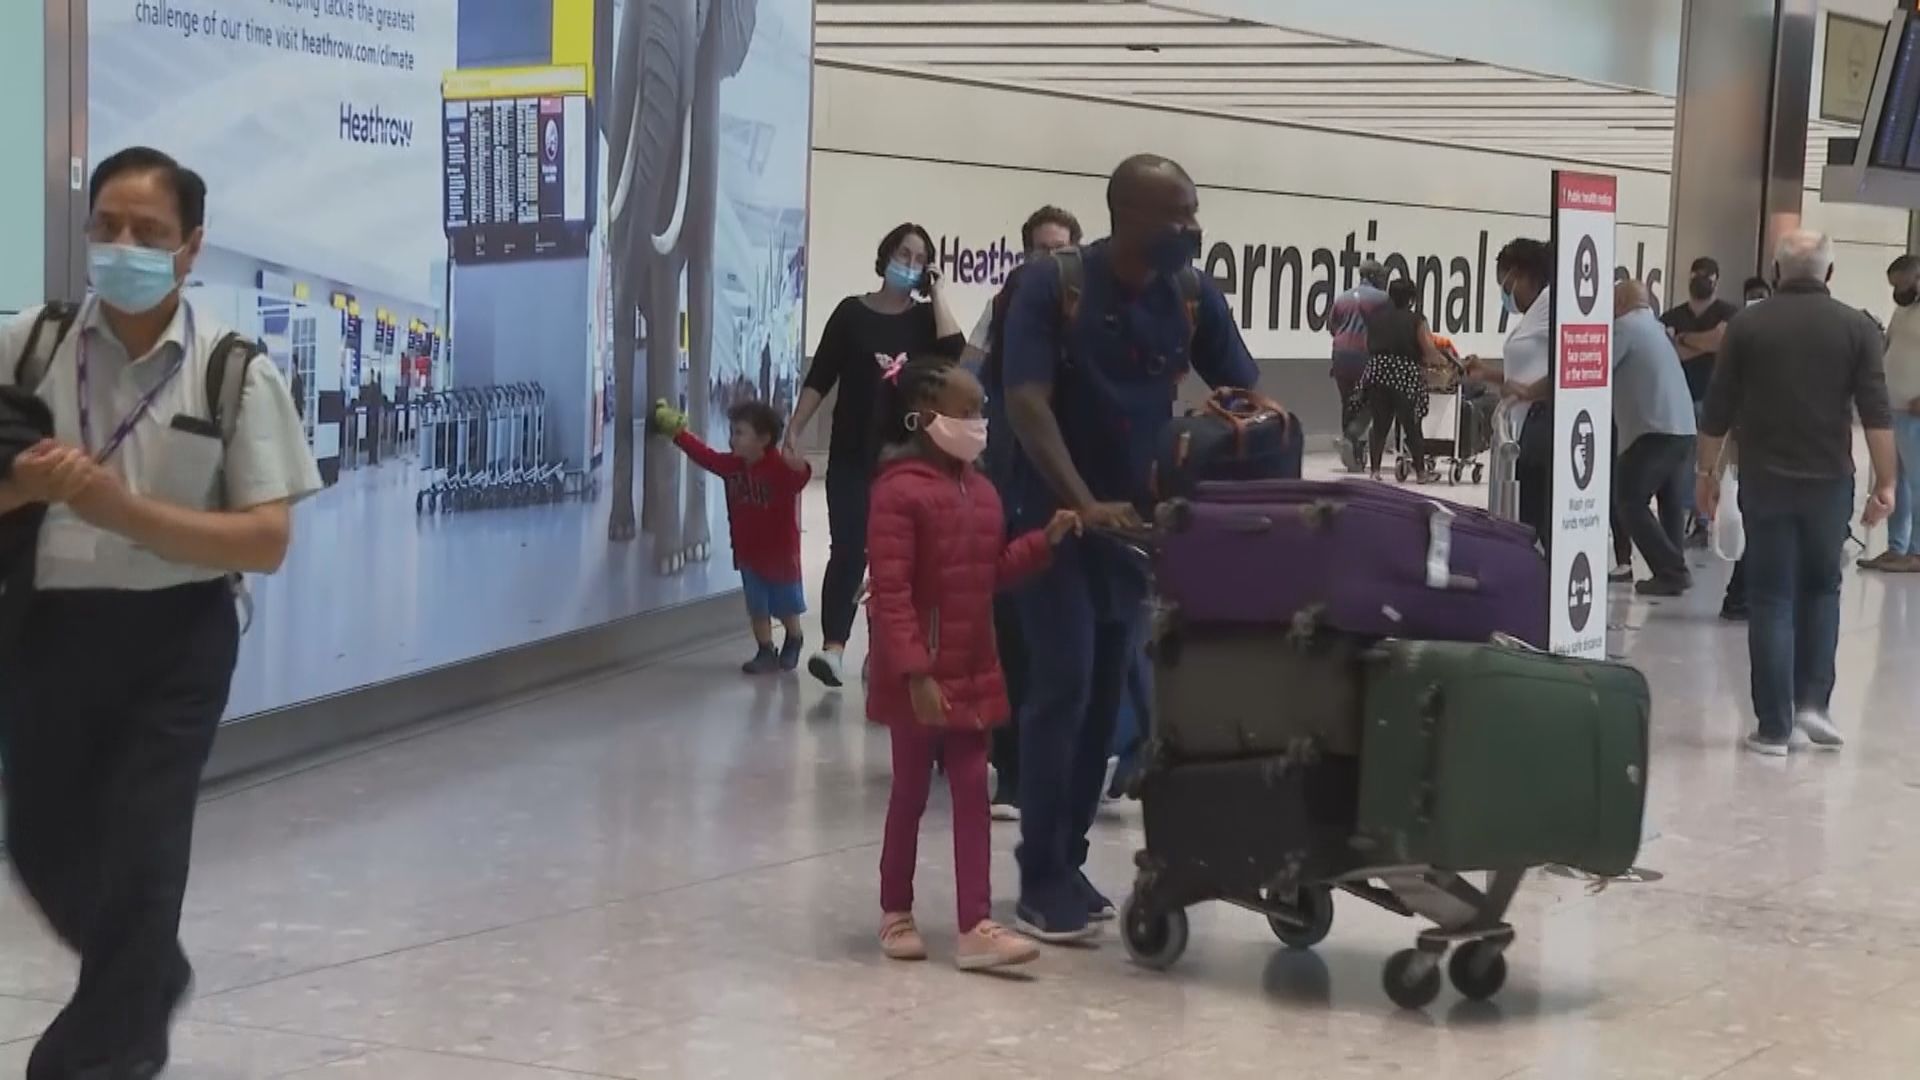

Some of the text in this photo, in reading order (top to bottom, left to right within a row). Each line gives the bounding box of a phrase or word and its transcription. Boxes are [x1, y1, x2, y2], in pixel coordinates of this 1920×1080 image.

[135, 0, 415, 70] challenge of our time visit heathrow.com/climate
[357, 0, 374, 23] the
[376, 7, 415, 32] greatest
[339, 101, 413, 147] Heathrow
[940, 234, 1024, 286] Heath
